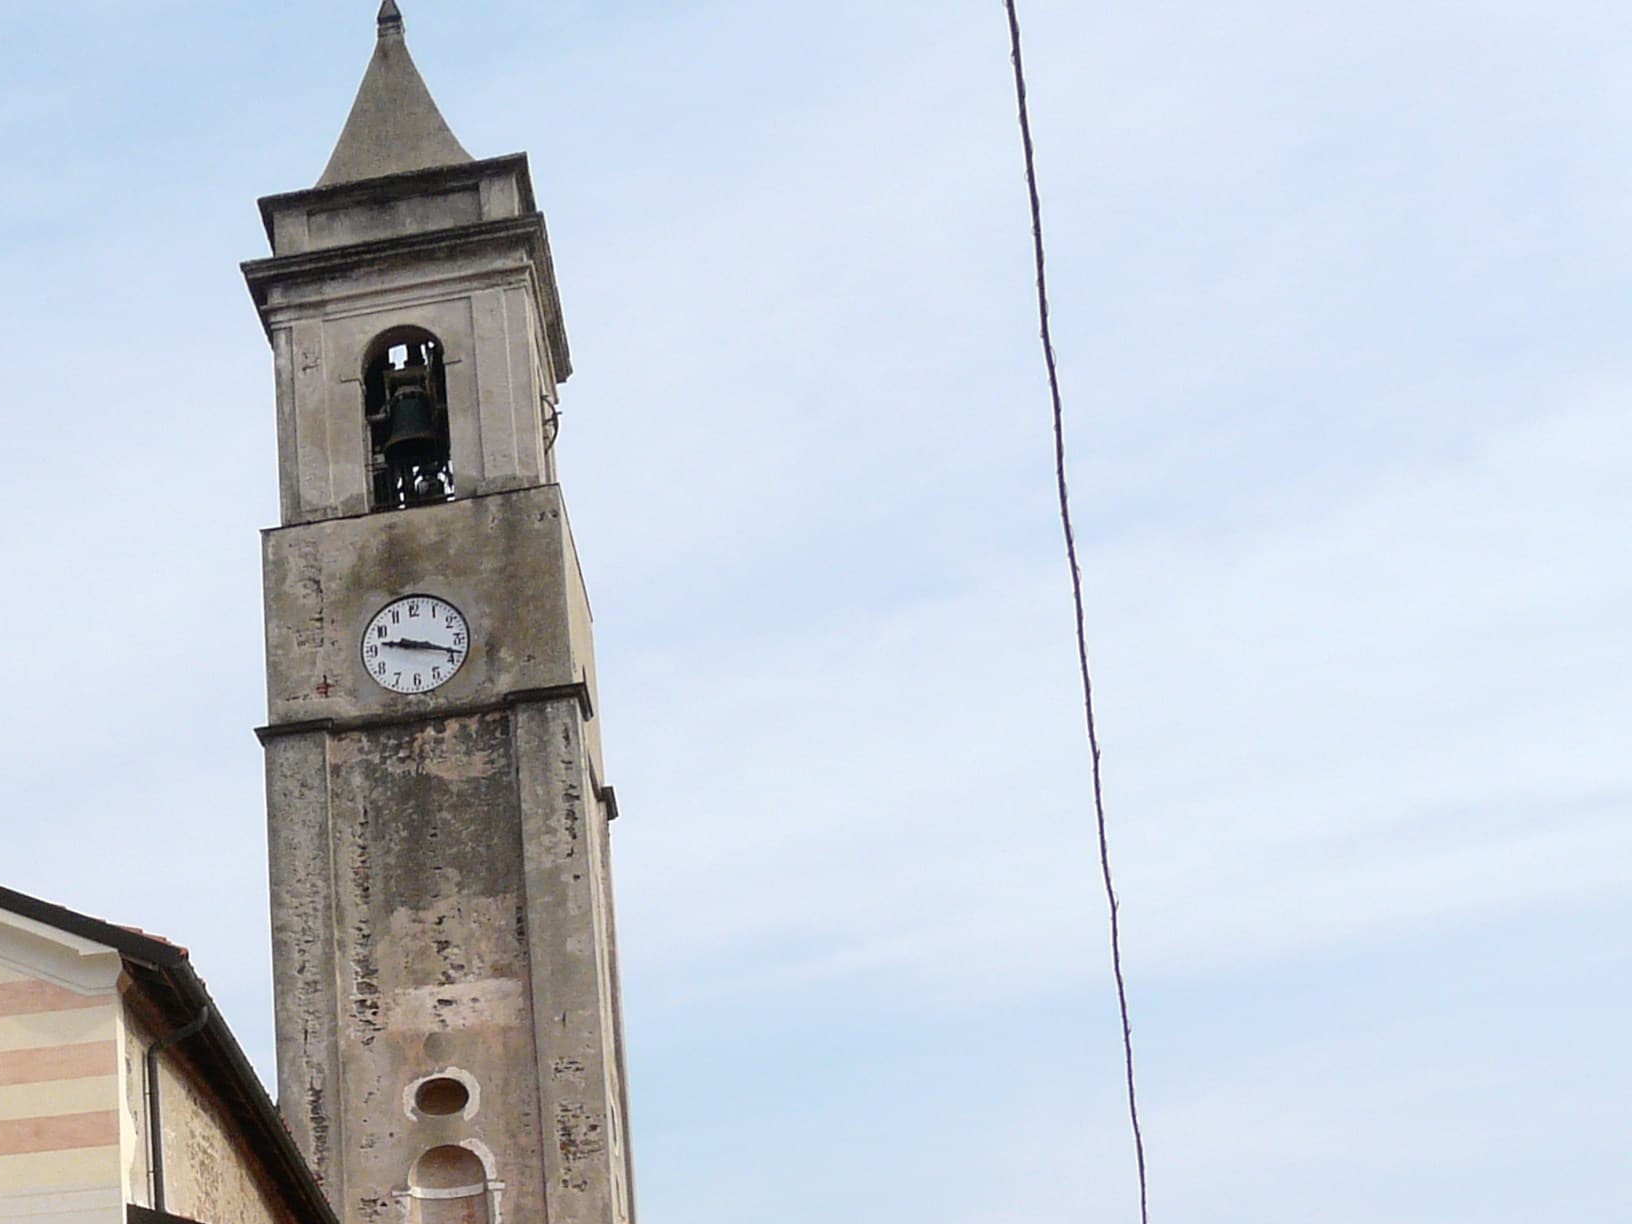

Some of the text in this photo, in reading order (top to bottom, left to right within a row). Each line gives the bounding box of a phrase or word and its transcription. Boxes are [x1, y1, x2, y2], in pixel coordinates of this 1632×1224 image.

[392, 610, 399, 625] 11
[409, 604, 420, 618] 12
[445, 616, 454, 629] 2
[377, 625, 388, 639] 10
[370, 645, 378, 658] 9
[378, 661, 386, 675] 8
[432, 666, 441, 680] 5
[393, 672, 402, 686] 7
[413, 673, 421, 687] 6
